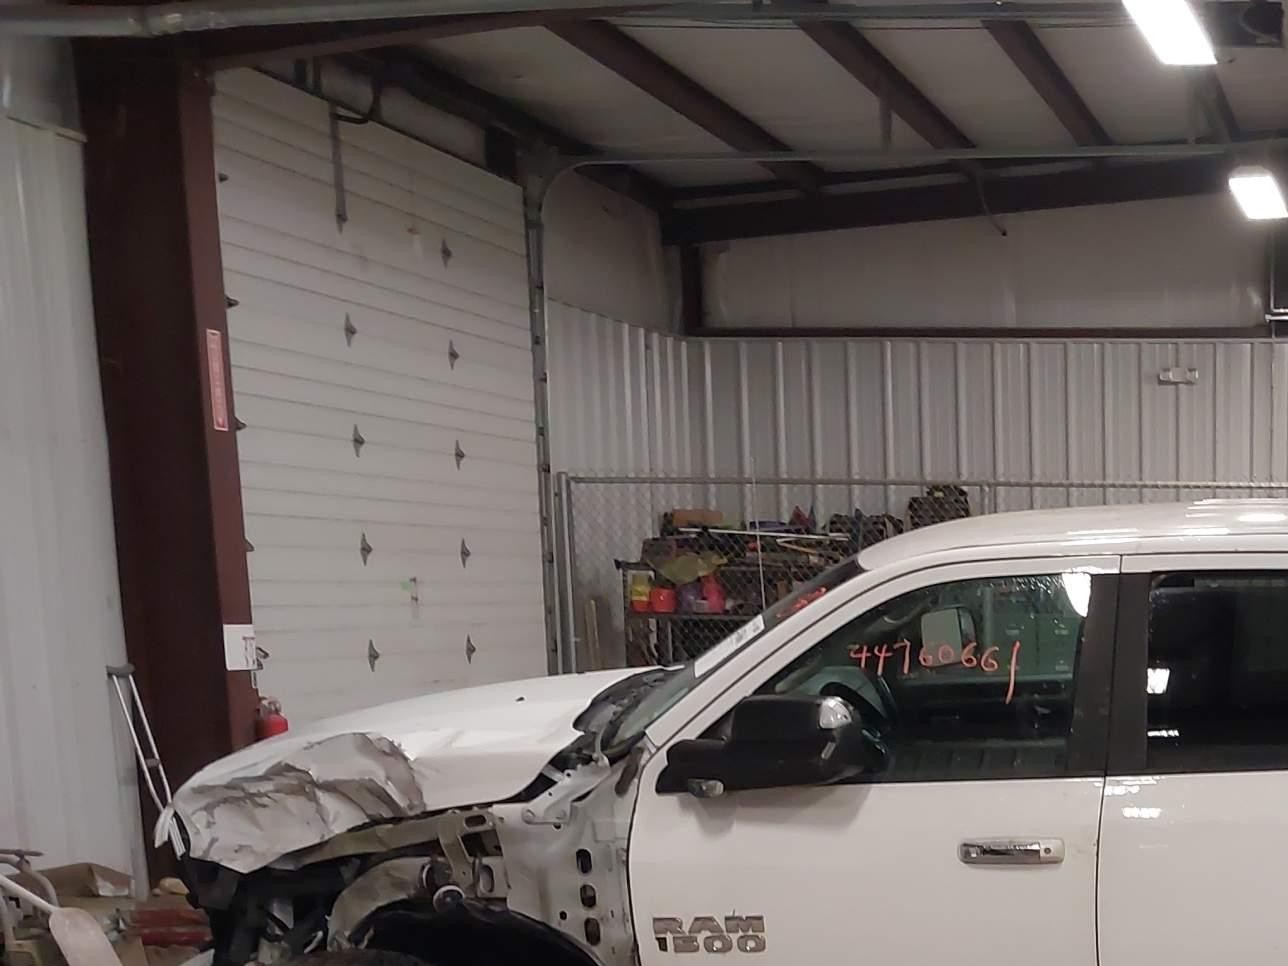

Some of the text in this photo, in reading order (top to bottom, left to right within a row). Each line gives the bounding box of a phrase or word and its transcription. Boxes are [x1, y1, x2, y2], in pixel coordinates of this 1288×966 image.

[848, 638, 1021, 705] 44760661
[652, 914, 765, 935] RAM
[655, 934, 767, 954] 1500
